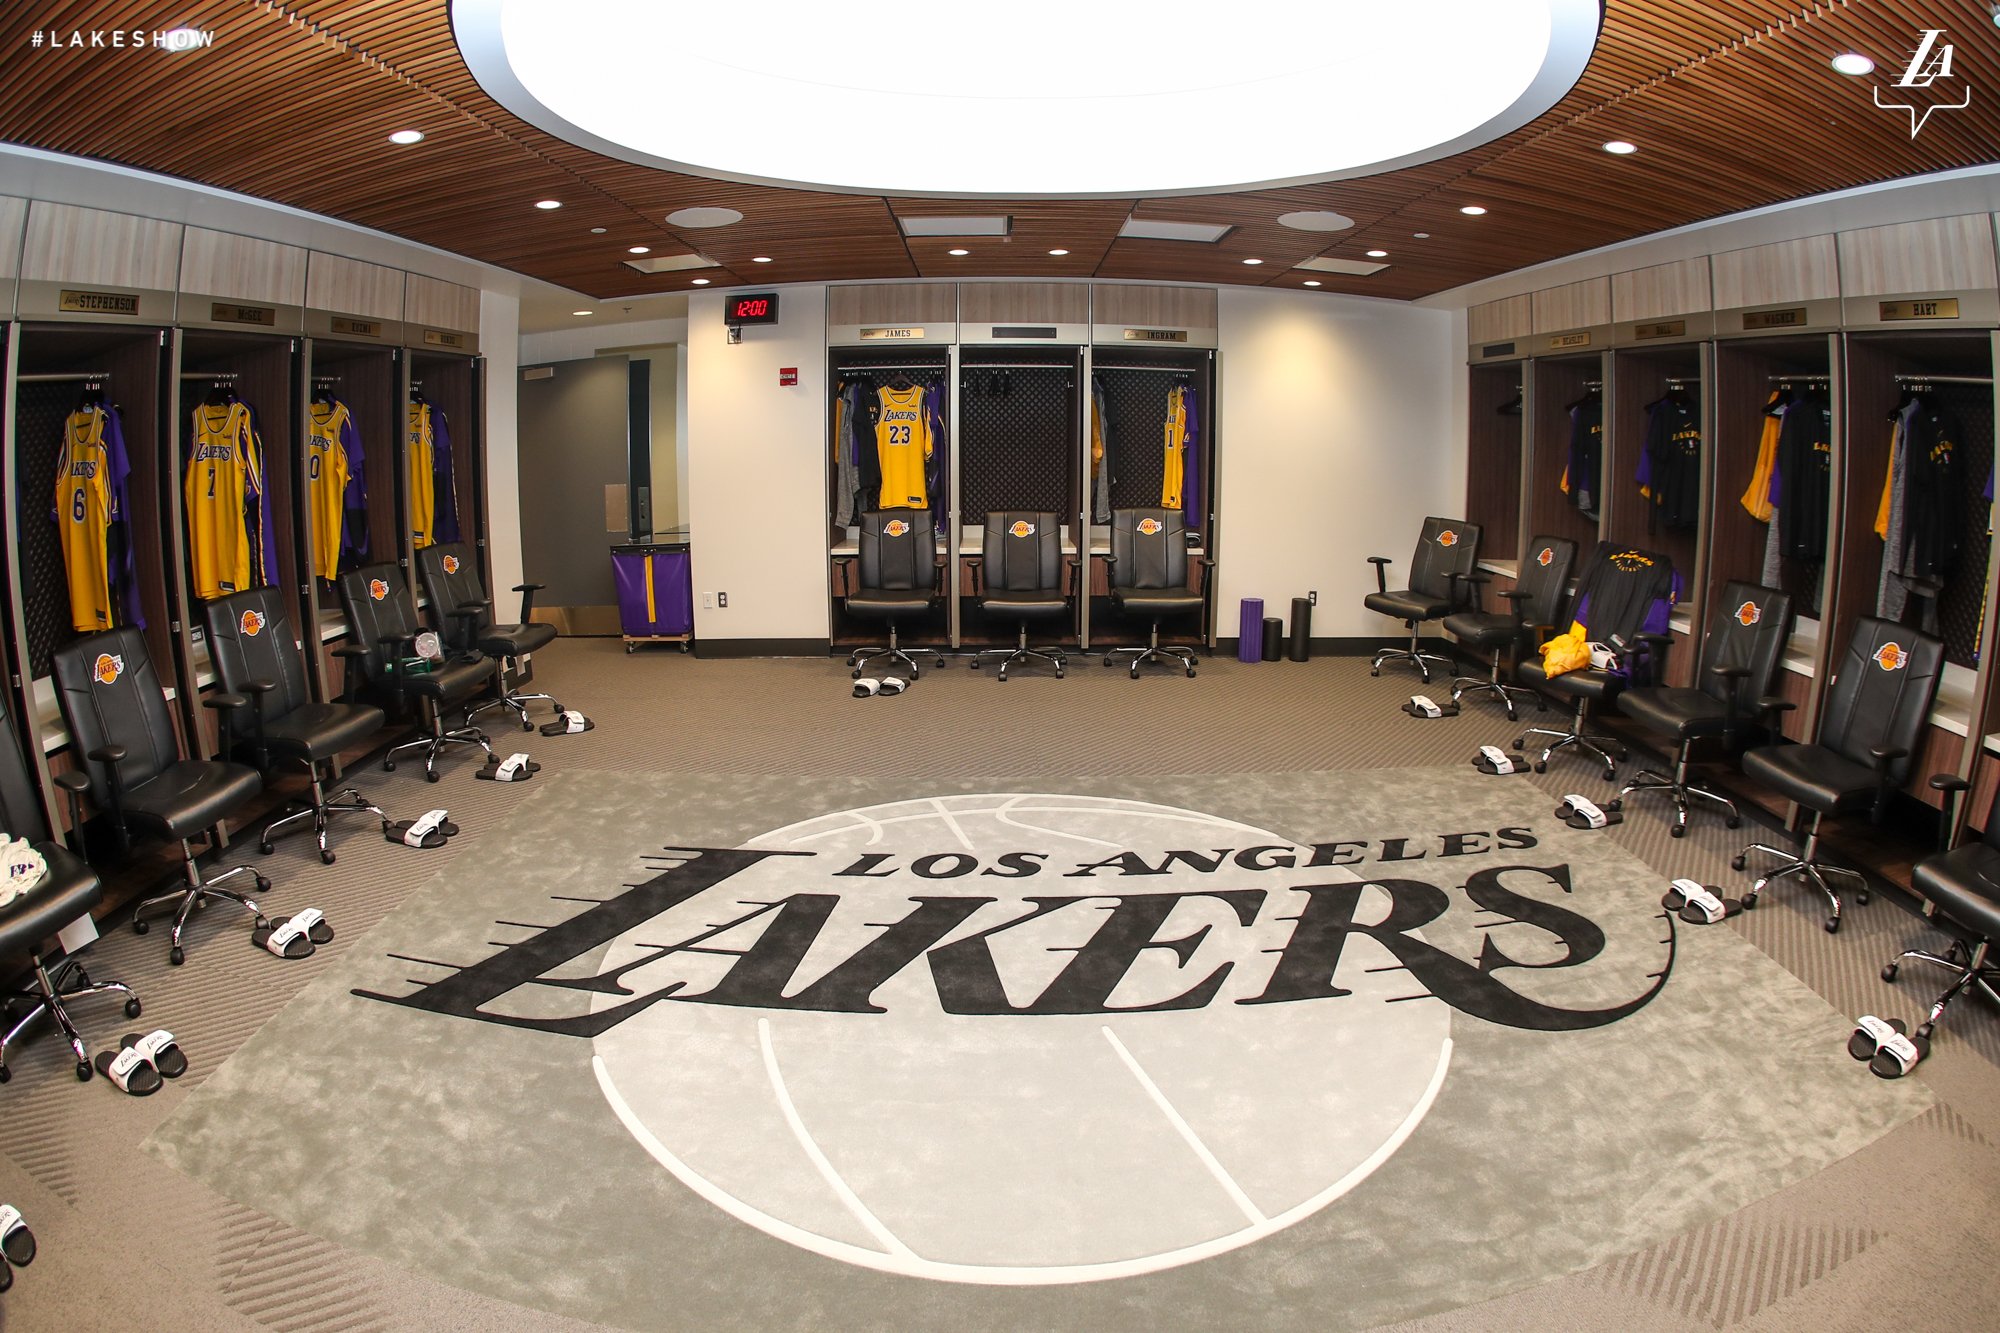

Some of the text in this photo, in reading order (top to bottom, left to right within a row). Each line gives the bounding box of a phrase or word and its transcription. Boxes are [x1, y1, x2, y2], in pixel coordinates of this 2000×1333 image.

[80, 294, 136, 311] STEPHENSON
[737, 300, 768, 317] 12:00
[1913, 303, 1938, 316] HART
[885, 330, 911, 338] JAMES
[1147, 331, 1177, 340] INGRAM
[884, 409, 917, 422] LAKERS
[889, 424, 911, 445] 23
[207, 467, 216, 499] 7
[72, 487, 86, 524] 6
[832, 826, 1539, 880] LOS ANGELES
[350, 846, 1677, 1037] LAKERS
